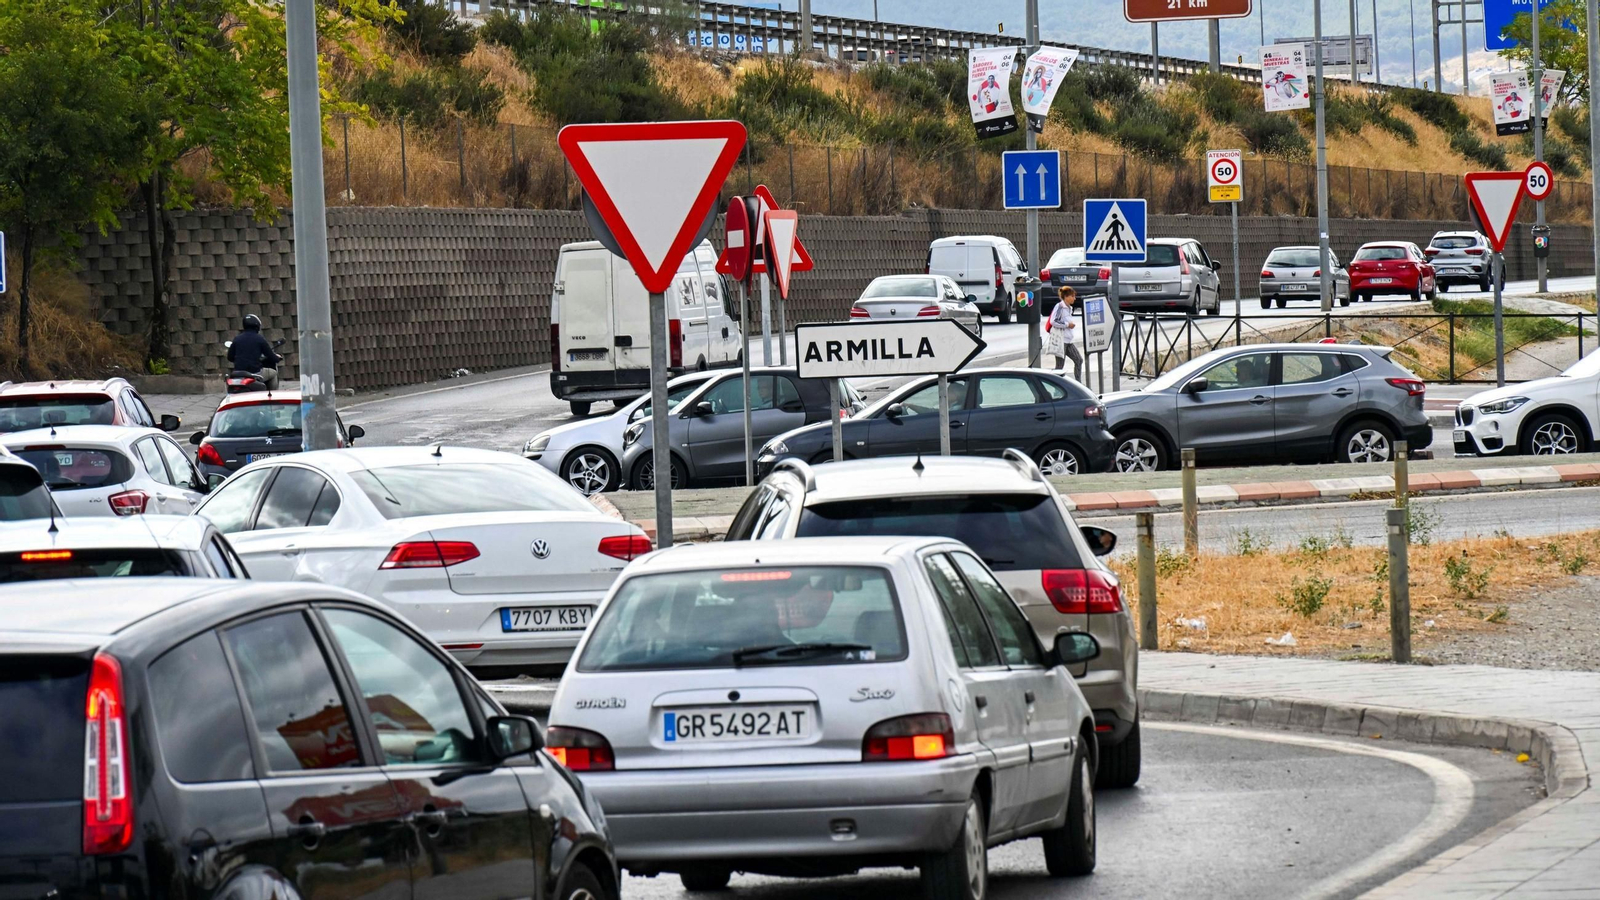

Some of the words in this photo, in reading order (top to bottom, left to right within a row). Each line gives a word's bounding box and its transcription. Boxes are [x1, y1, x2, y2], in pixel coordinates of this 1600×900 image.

[1167, 0, 1181, 9] 21
[1218, 167, 1231, 176] 50
[1530, 175, 1546, 188] 50
[804, 336, 935, 363] ARMILLA
[512, 609, 552, 626] 7707
[558, 608, 587, 624] KBY
[849, 687, 896, 703] Saxo
[575, 697, 626, 709] CITROËN
[677, 714, 705, 738] GR
[710, 712, 771, 736] 5492
[776, 710, 805, 735] AT
